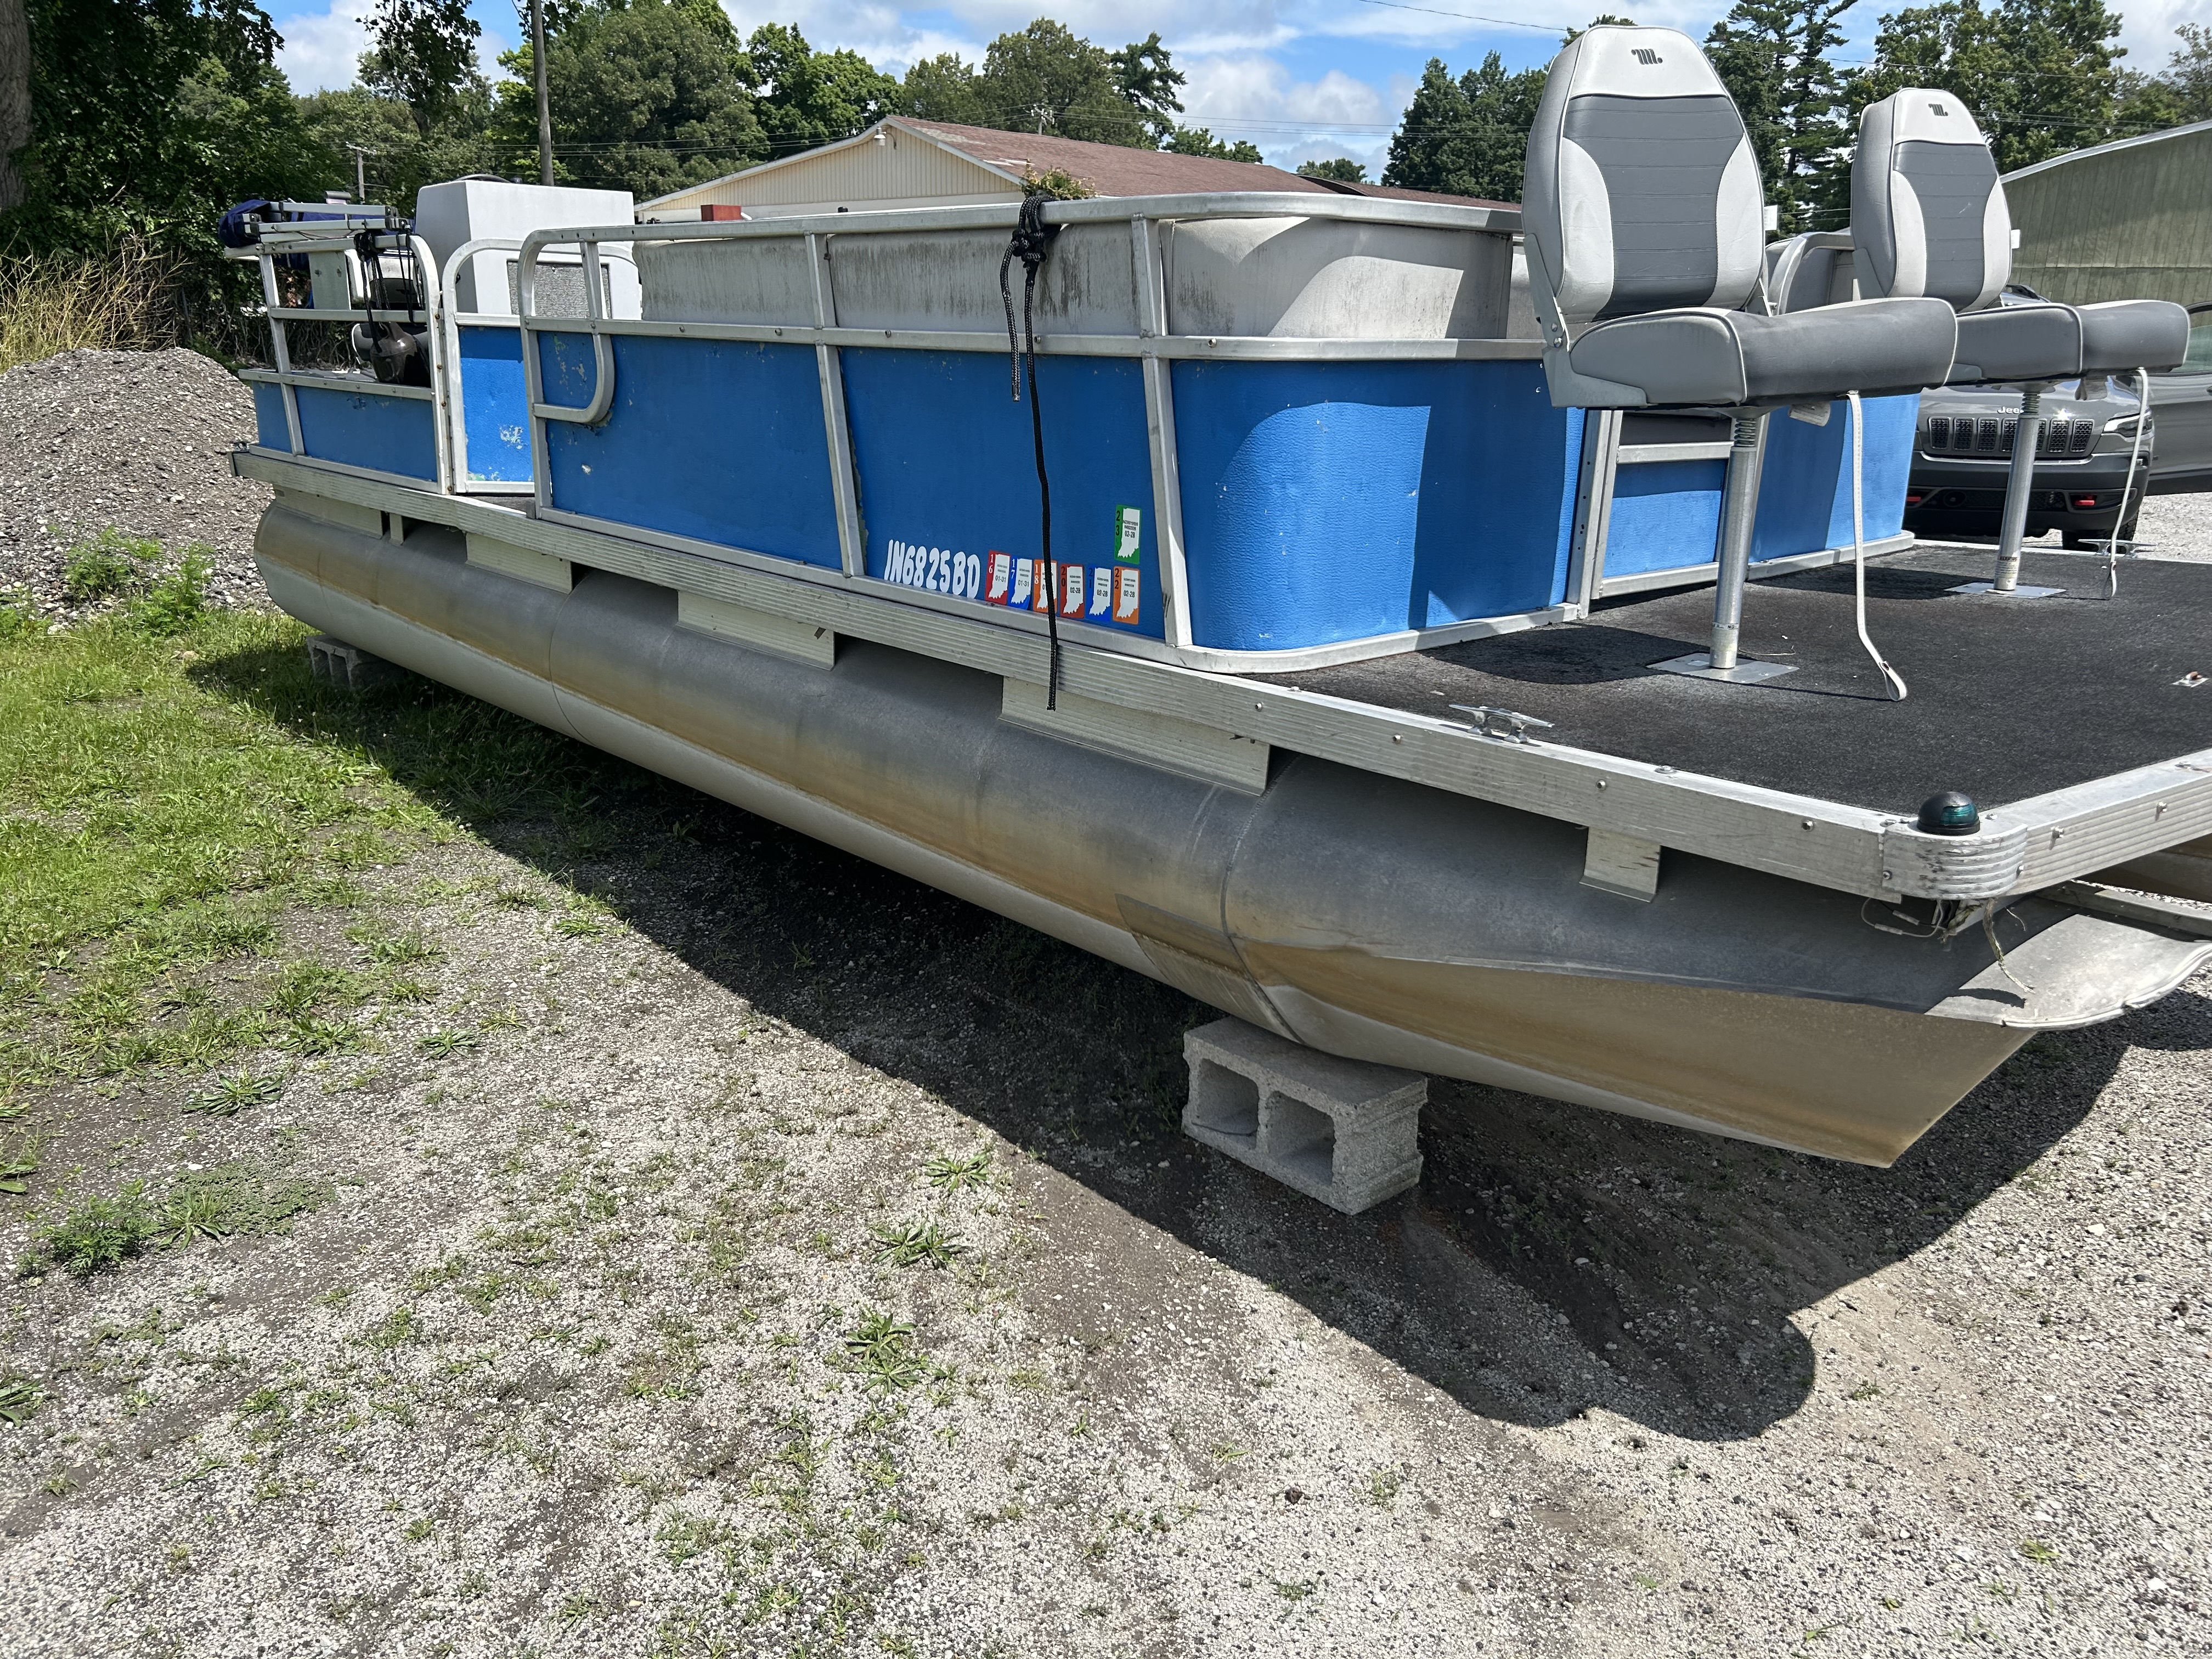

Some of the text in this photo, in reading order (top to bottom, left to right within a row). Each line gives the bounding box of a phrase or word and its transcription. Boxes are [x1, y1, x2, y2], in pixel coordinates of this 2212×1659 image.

[884, 539, 980, 599] IN6825BD
[995, 574, 1006, 583] 01-31
[1018, 579, 1029, 588] 01-31
